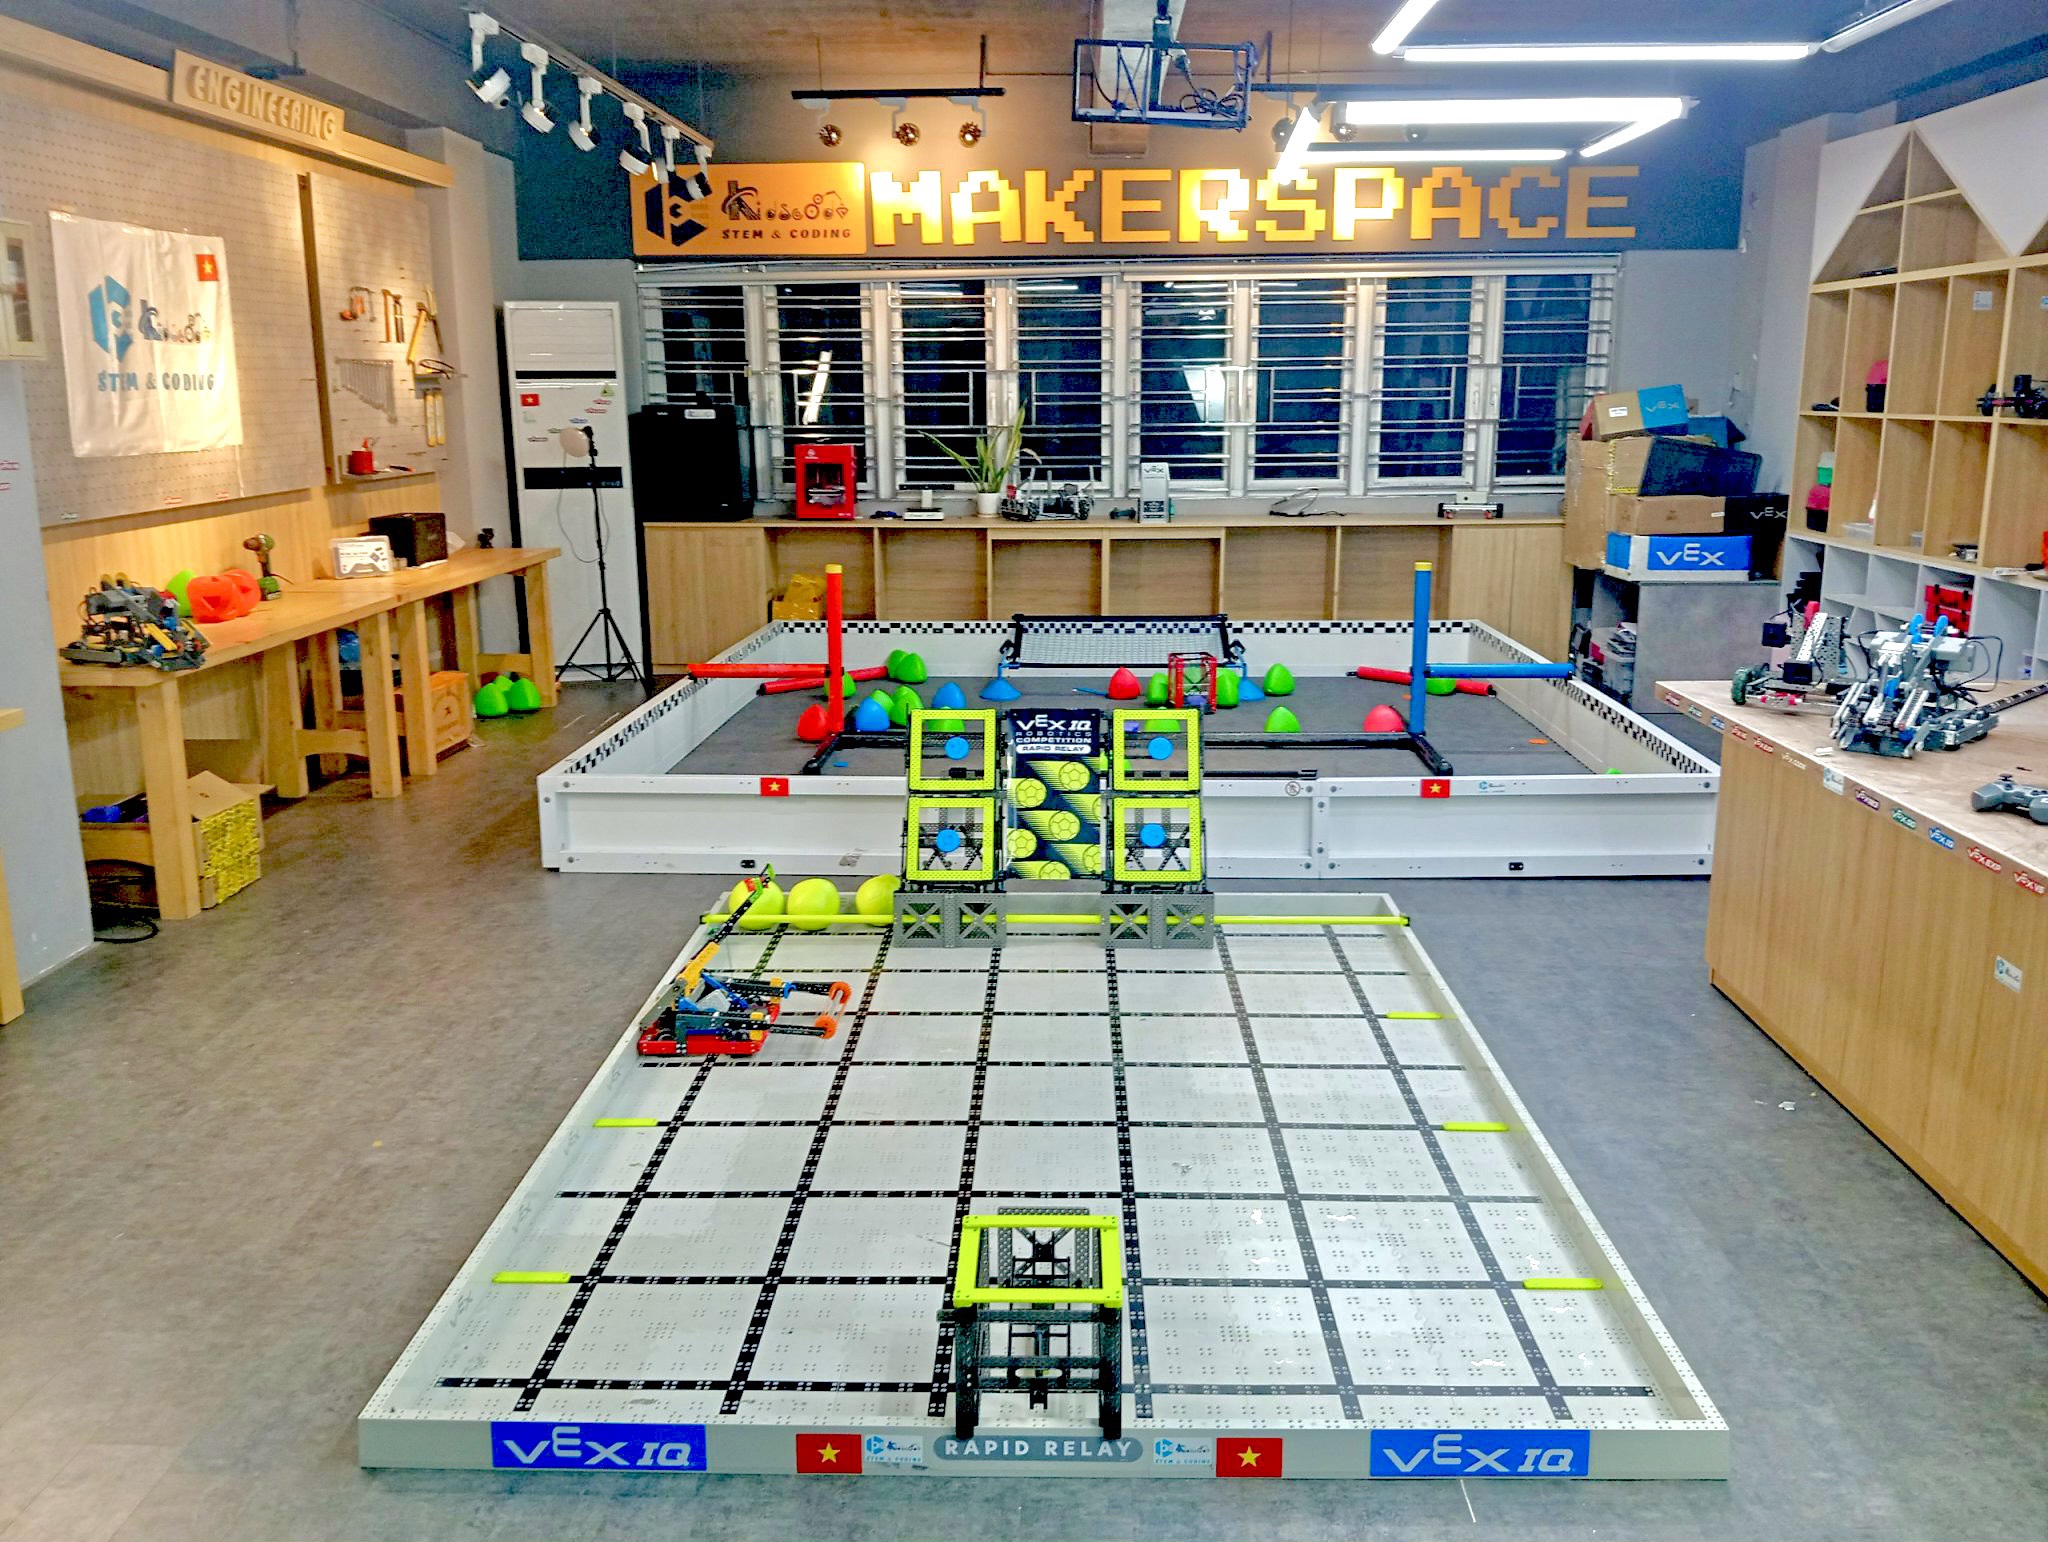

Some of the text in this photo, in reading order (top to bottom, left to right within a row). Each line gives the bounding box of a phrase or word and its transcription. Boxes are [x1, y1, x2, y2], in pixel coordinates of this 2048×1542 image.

[192, 65, 336, 141] ENGINEERING
[869, 166, 1640, 246] MAKERSPACE
[721, 228, 851, 240] STEM & CODING
[145, 371, 157, 390] &
[161, 372, 215, 391] CODING
[1645, 401, 1681, 413] VEX
[1750, 506, 1788, 520] VEX
[1656, 543, 1725, 566] VEX
[1016, 714, 1092, 731] VEX IQ
[503, 1426, 692, 1467] VEX IQ
[945, 1440, 1132, 1457] RAPID RELAY
[1382, 1433, 1575, 1473] VEX IQ
